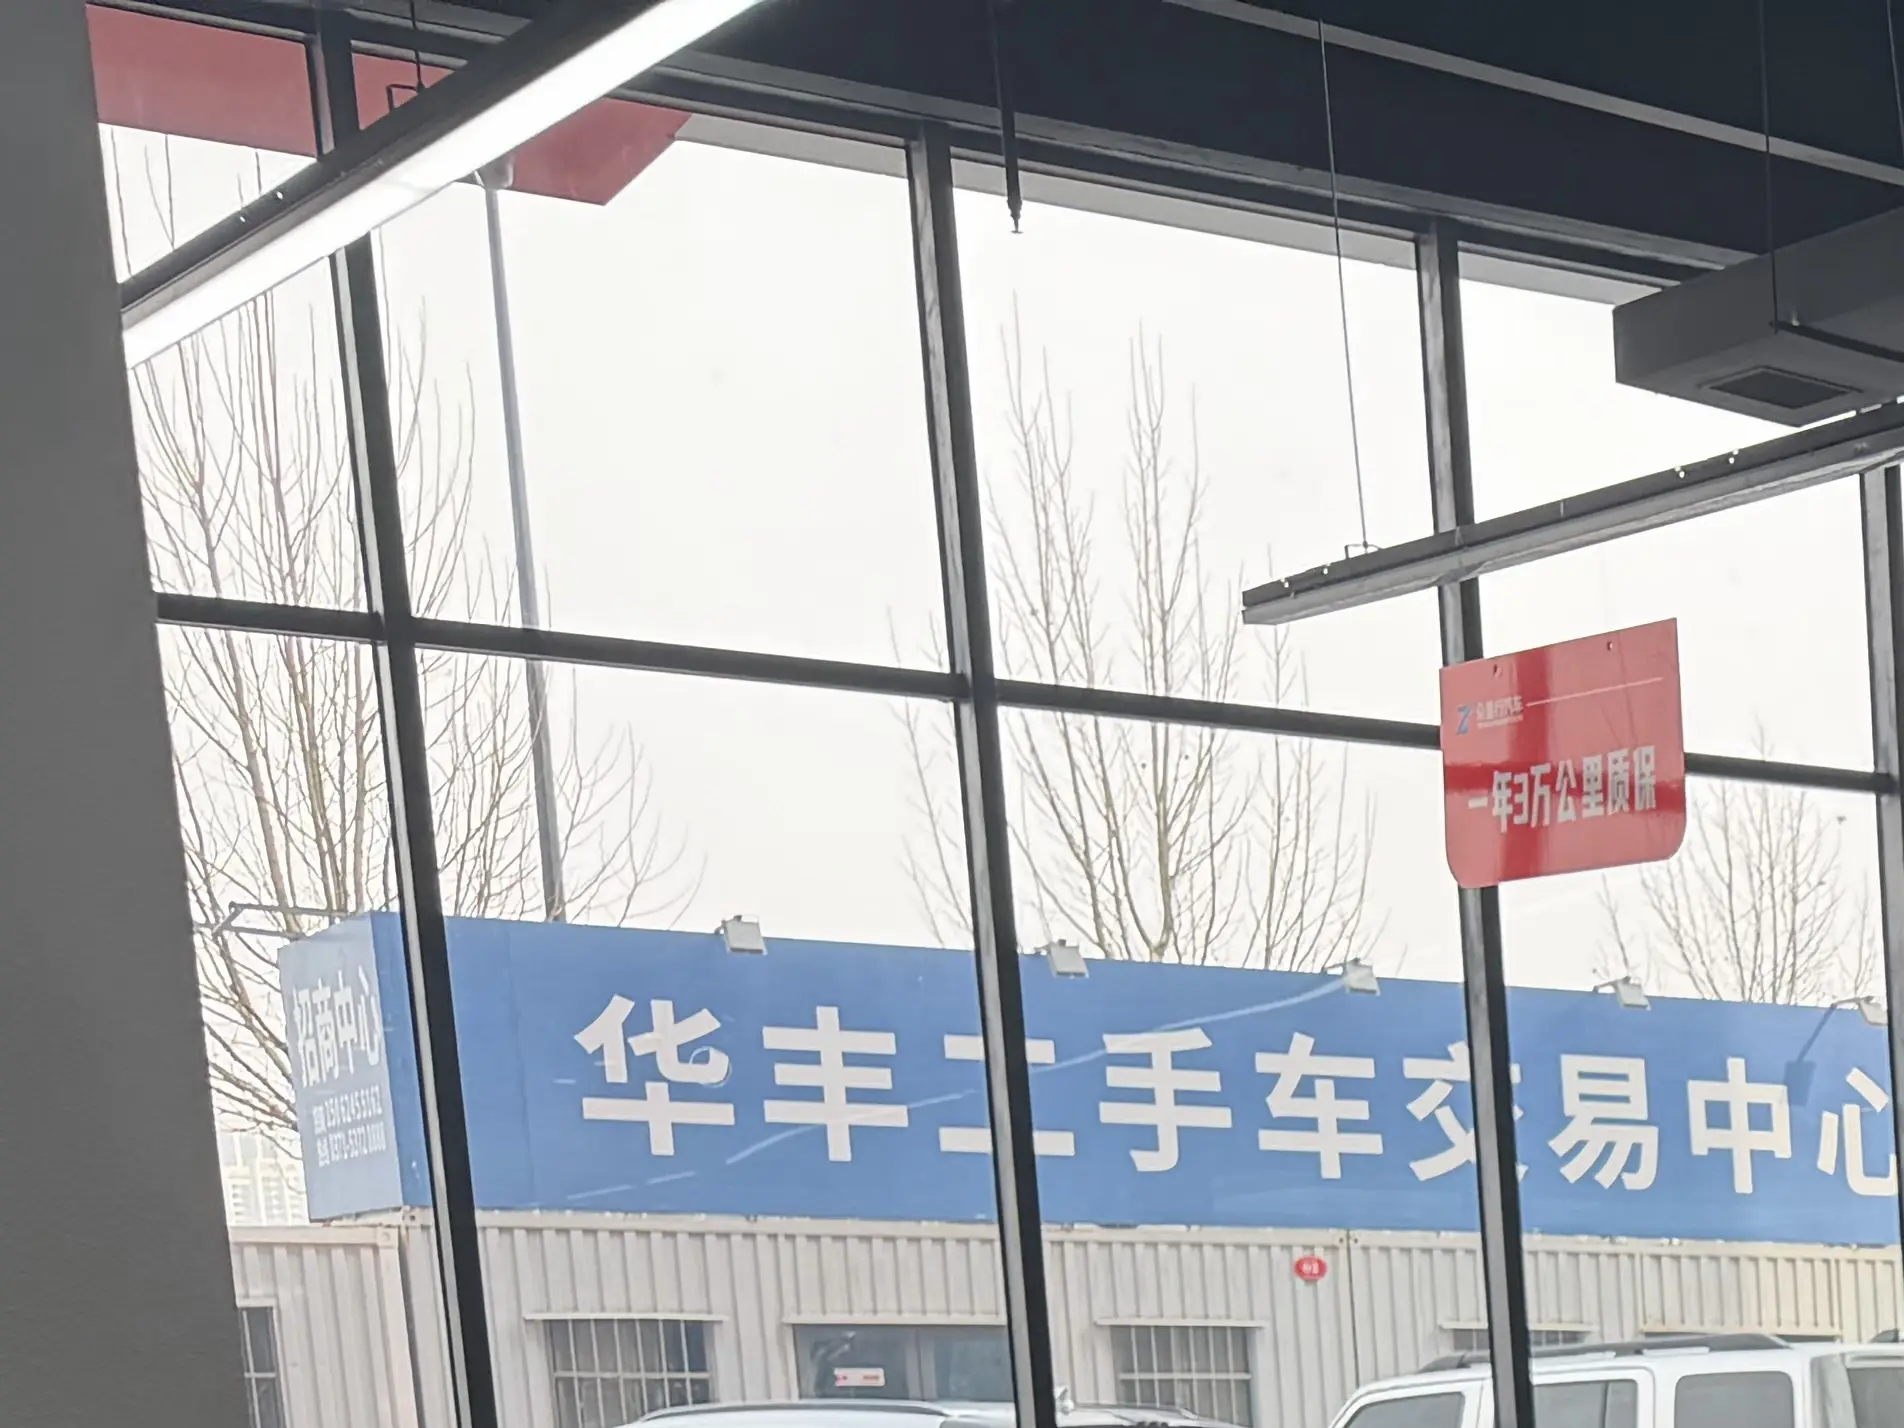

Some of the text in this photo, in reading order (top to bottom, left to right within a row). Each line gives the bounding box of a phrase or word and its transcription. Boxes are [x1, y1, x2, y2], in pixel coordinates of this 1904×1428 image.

[1468, 745, 1657, 834] 一年3万公里质保
